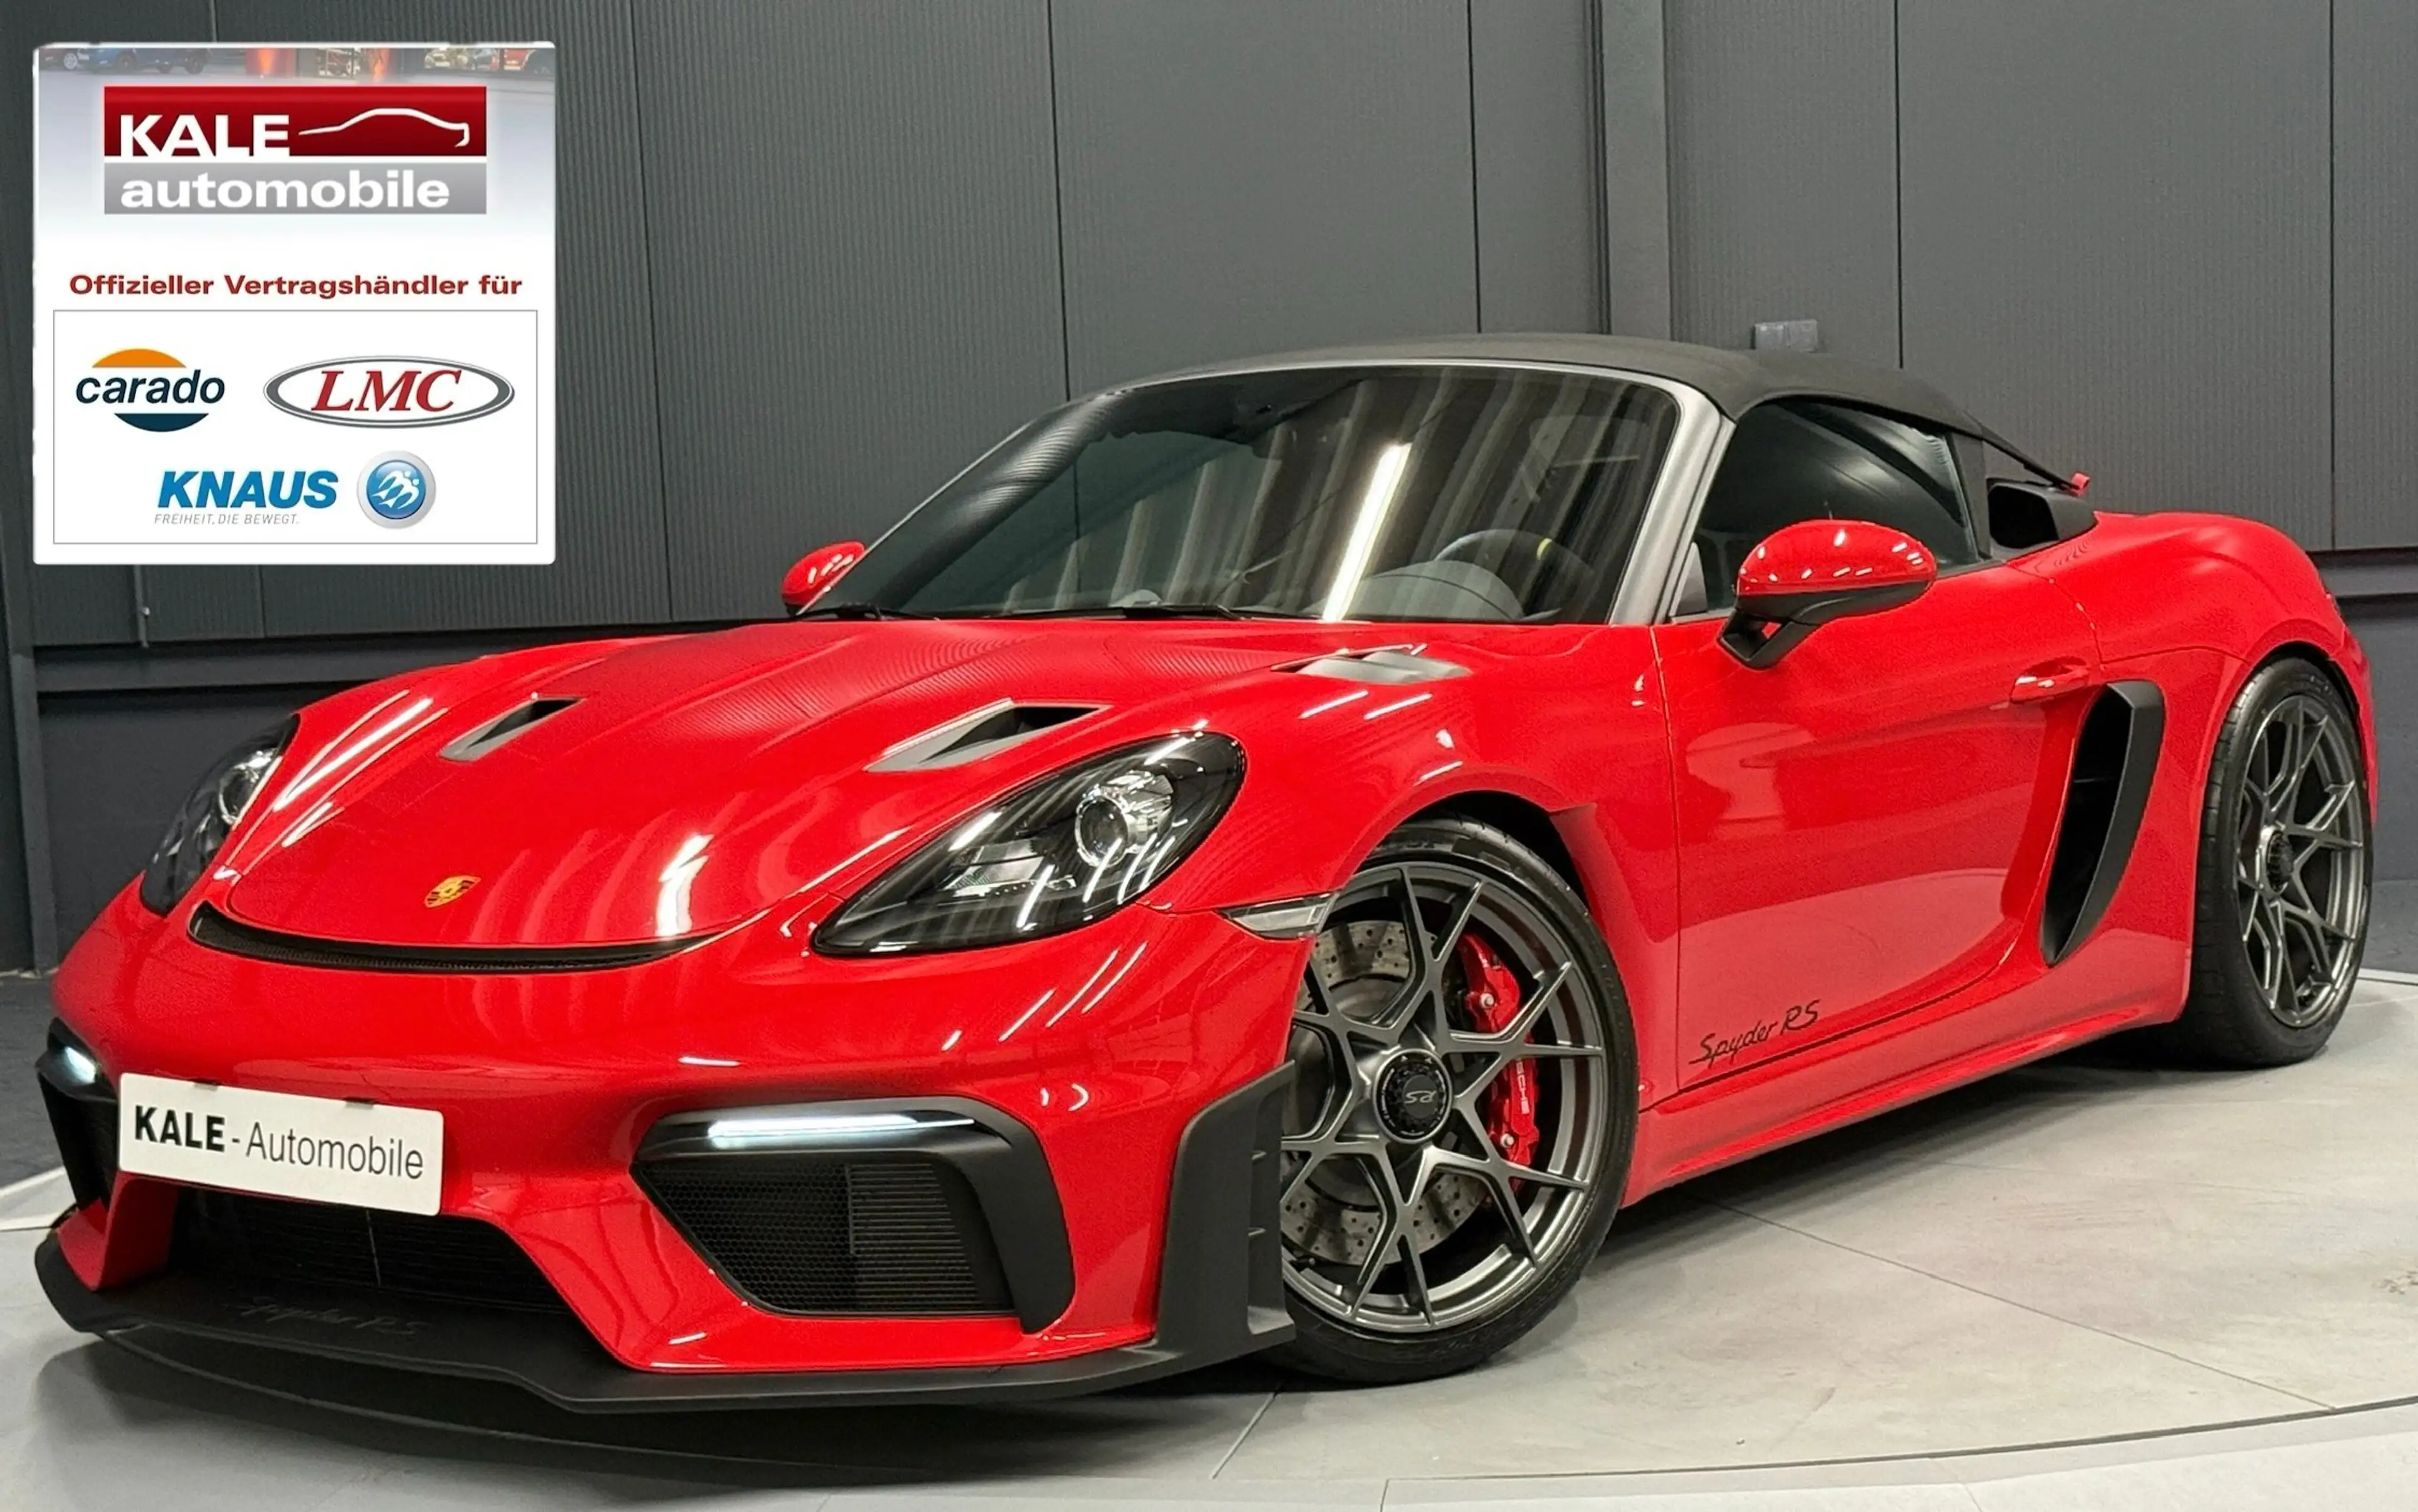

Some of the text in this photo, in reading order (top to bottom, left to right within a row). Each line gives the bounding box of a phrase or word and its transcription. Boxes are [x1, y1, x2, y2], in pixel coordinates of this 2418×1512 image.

[1688, 999, 1821, 1069] Spyder RS
[134, 1105, 225, 1152] KALE
[246, 1121, 424, 1179] Automobile
